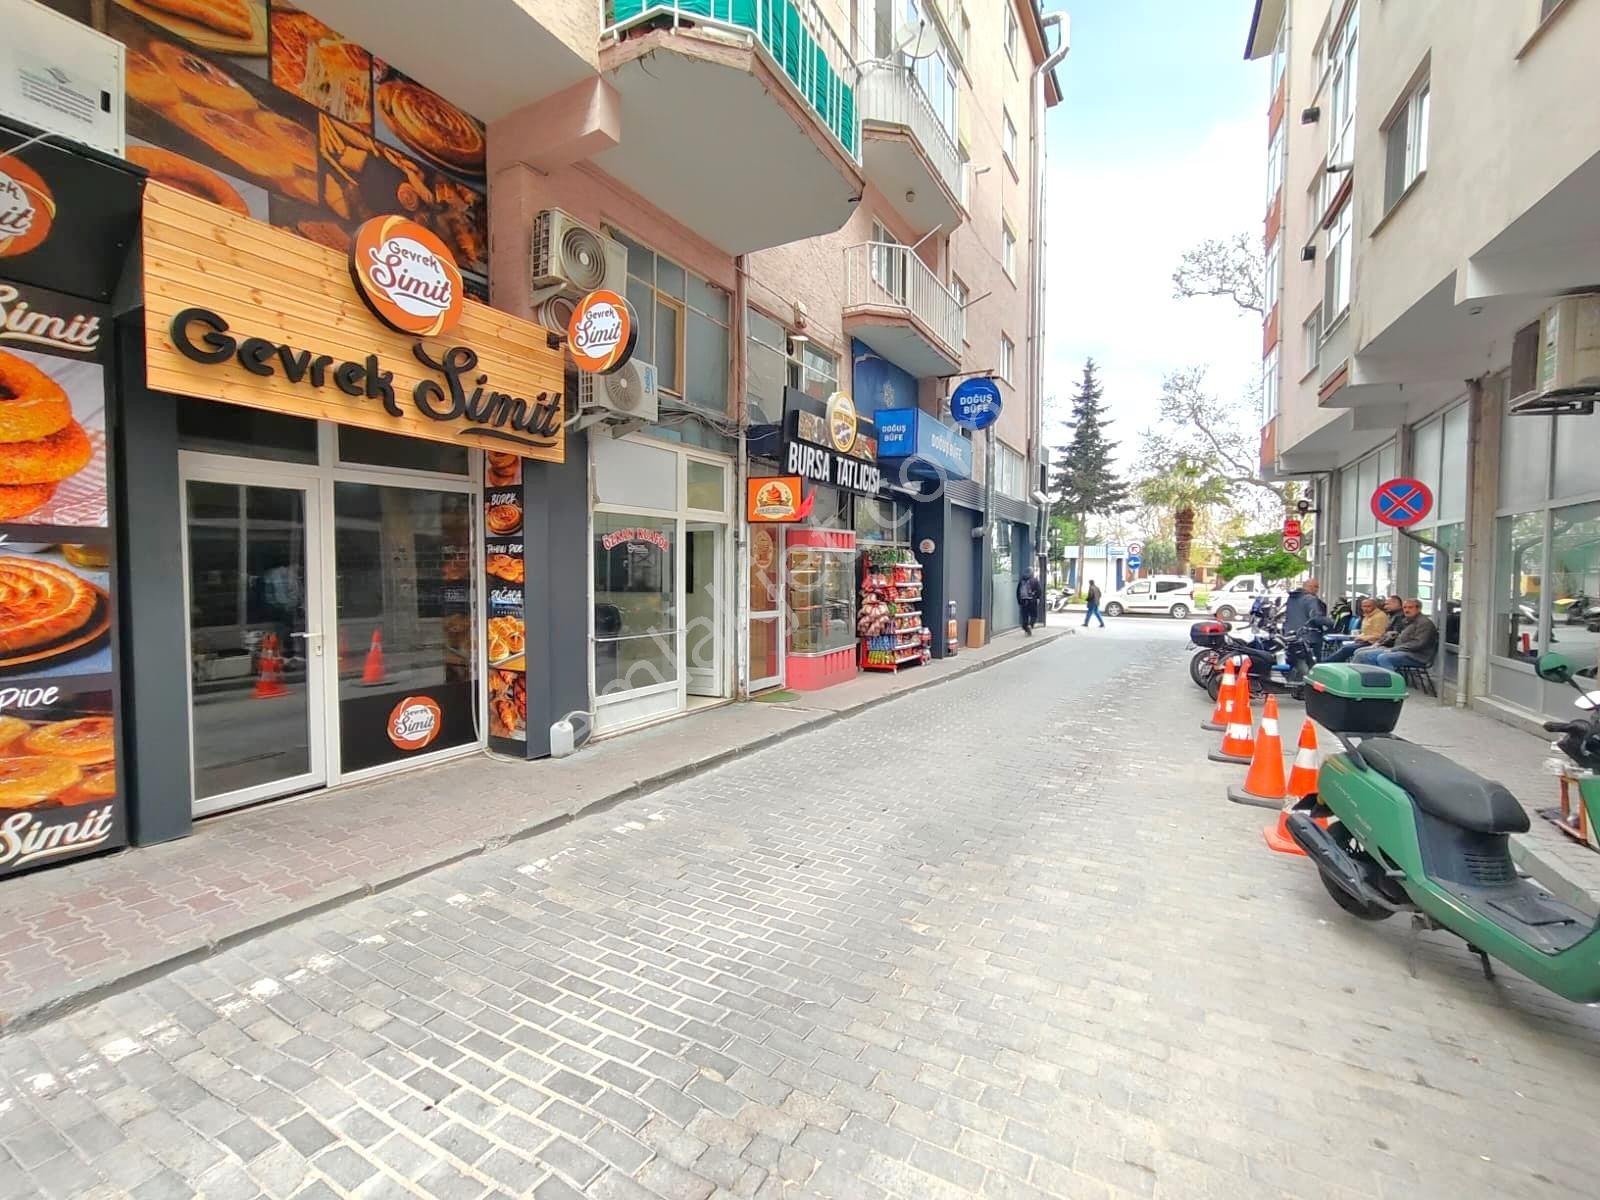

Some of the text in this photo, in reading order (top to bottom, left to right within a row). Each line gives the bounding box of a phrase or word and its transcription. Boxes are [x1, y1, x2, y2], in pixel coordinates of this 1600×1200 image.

[388, 241, 440, 274] Gevrek
[370, 251, 451, 308] Simit
[586, 308, 615, 320] Gevrek
[576, 320, 621, 348] Simit
[169, 307, 562, 448] Gevrek Simit
[960, 394, 993, 406] DOĞUŞ
[963, 404, 989, 414] BÜFE
[881, 424, 907, 433] DOĞUŞ
[884, 433, 904, 442] BÜFE
[788, 441, 881, 494] BURSA TATLICISI
[602, 528, 634, 550] ÖZKAN
[395, 714, 433, 736] Simit
